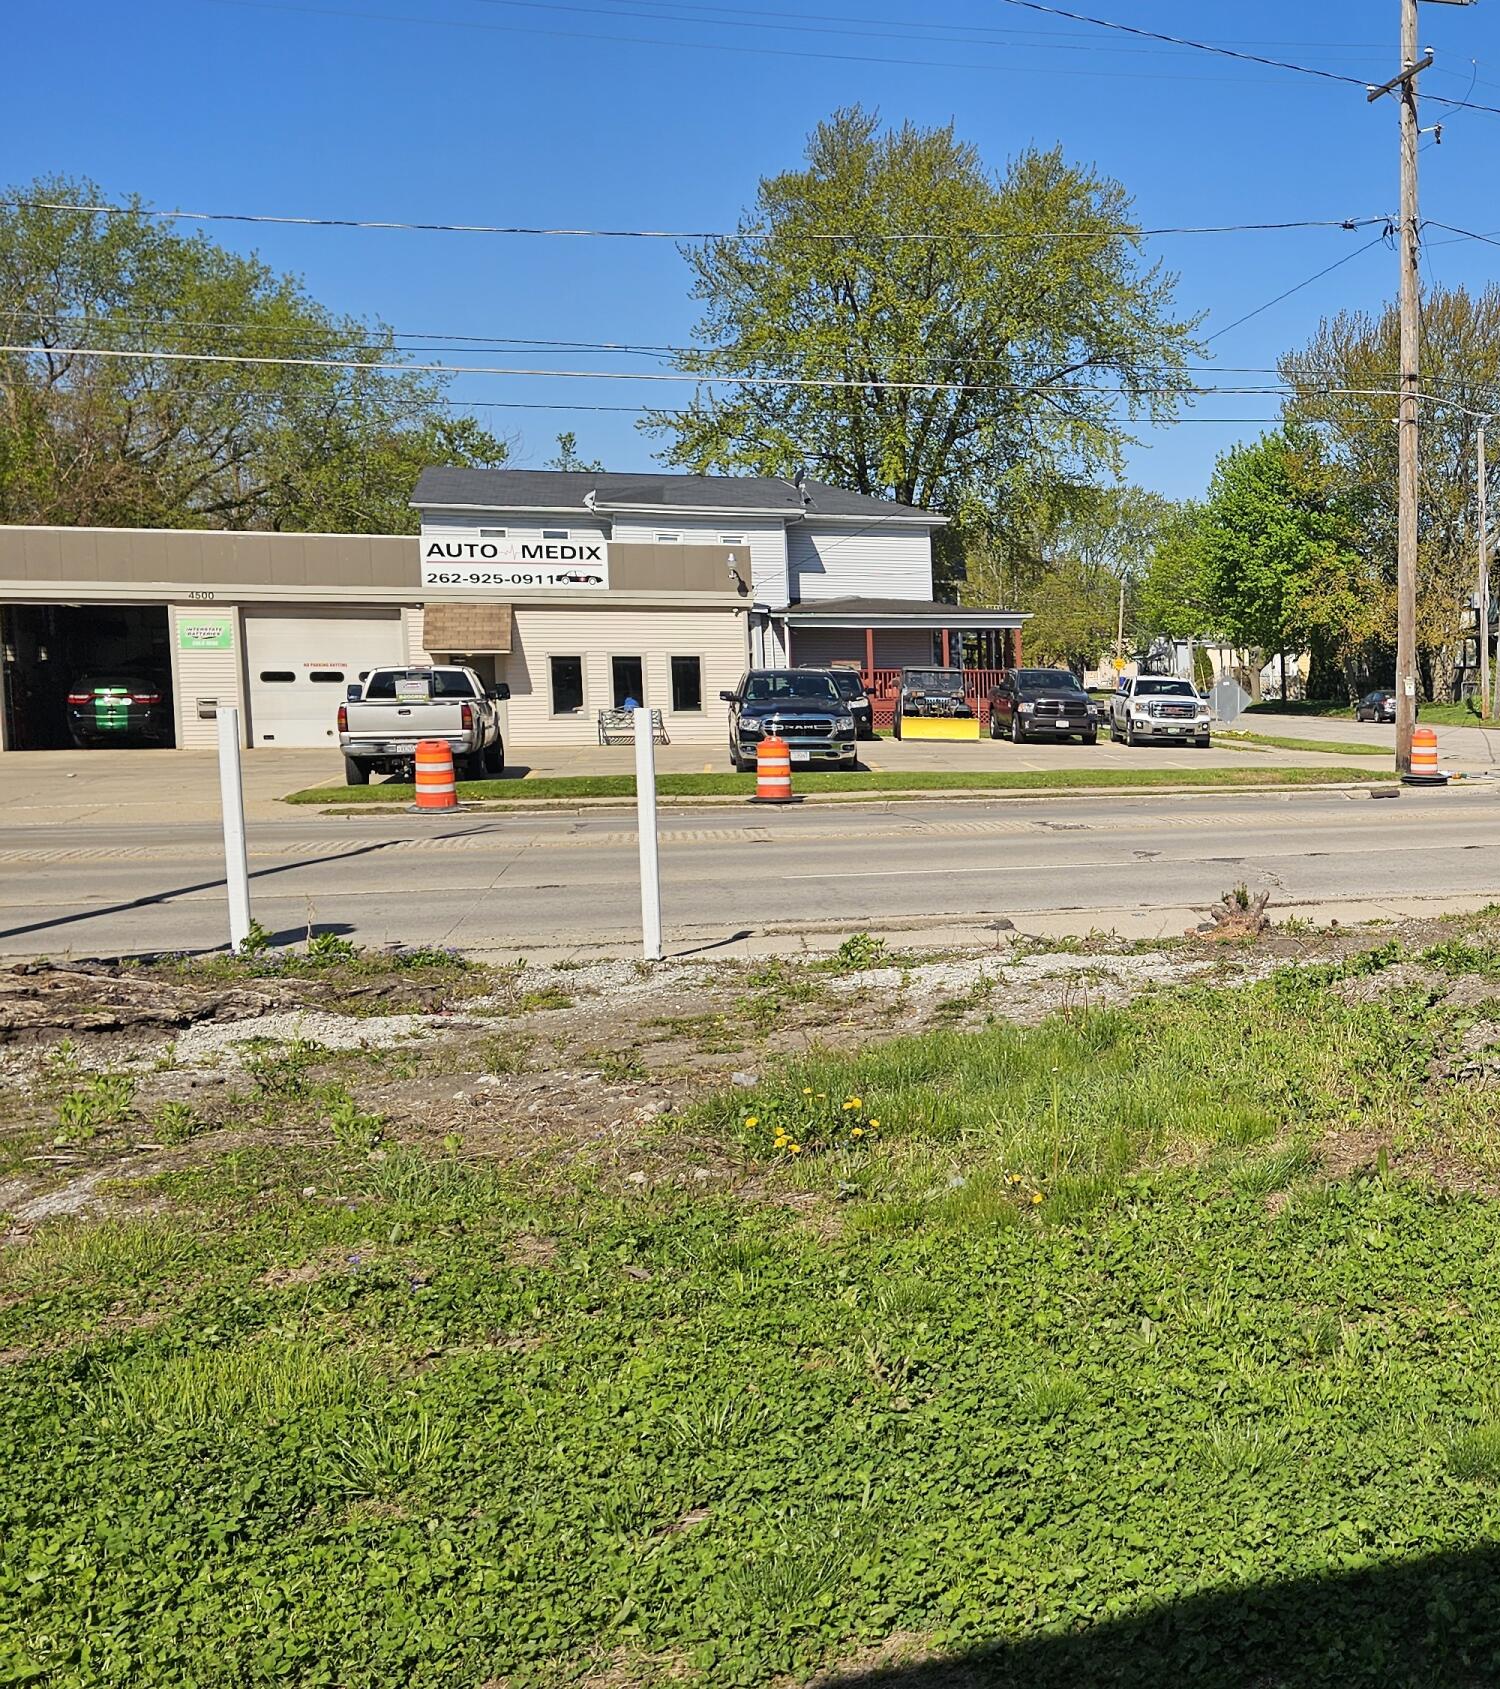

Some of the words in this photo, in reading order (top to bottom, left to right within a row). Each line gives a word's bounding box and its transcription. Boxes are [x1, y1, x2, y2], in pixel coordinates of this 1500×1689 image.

[427, 543, 498, 558] AUTO
[521, 545, 602, 560] MEDIX
[427, 573, 554, 585] 262-925-0911
[188, 591, 214, 600] 4500
